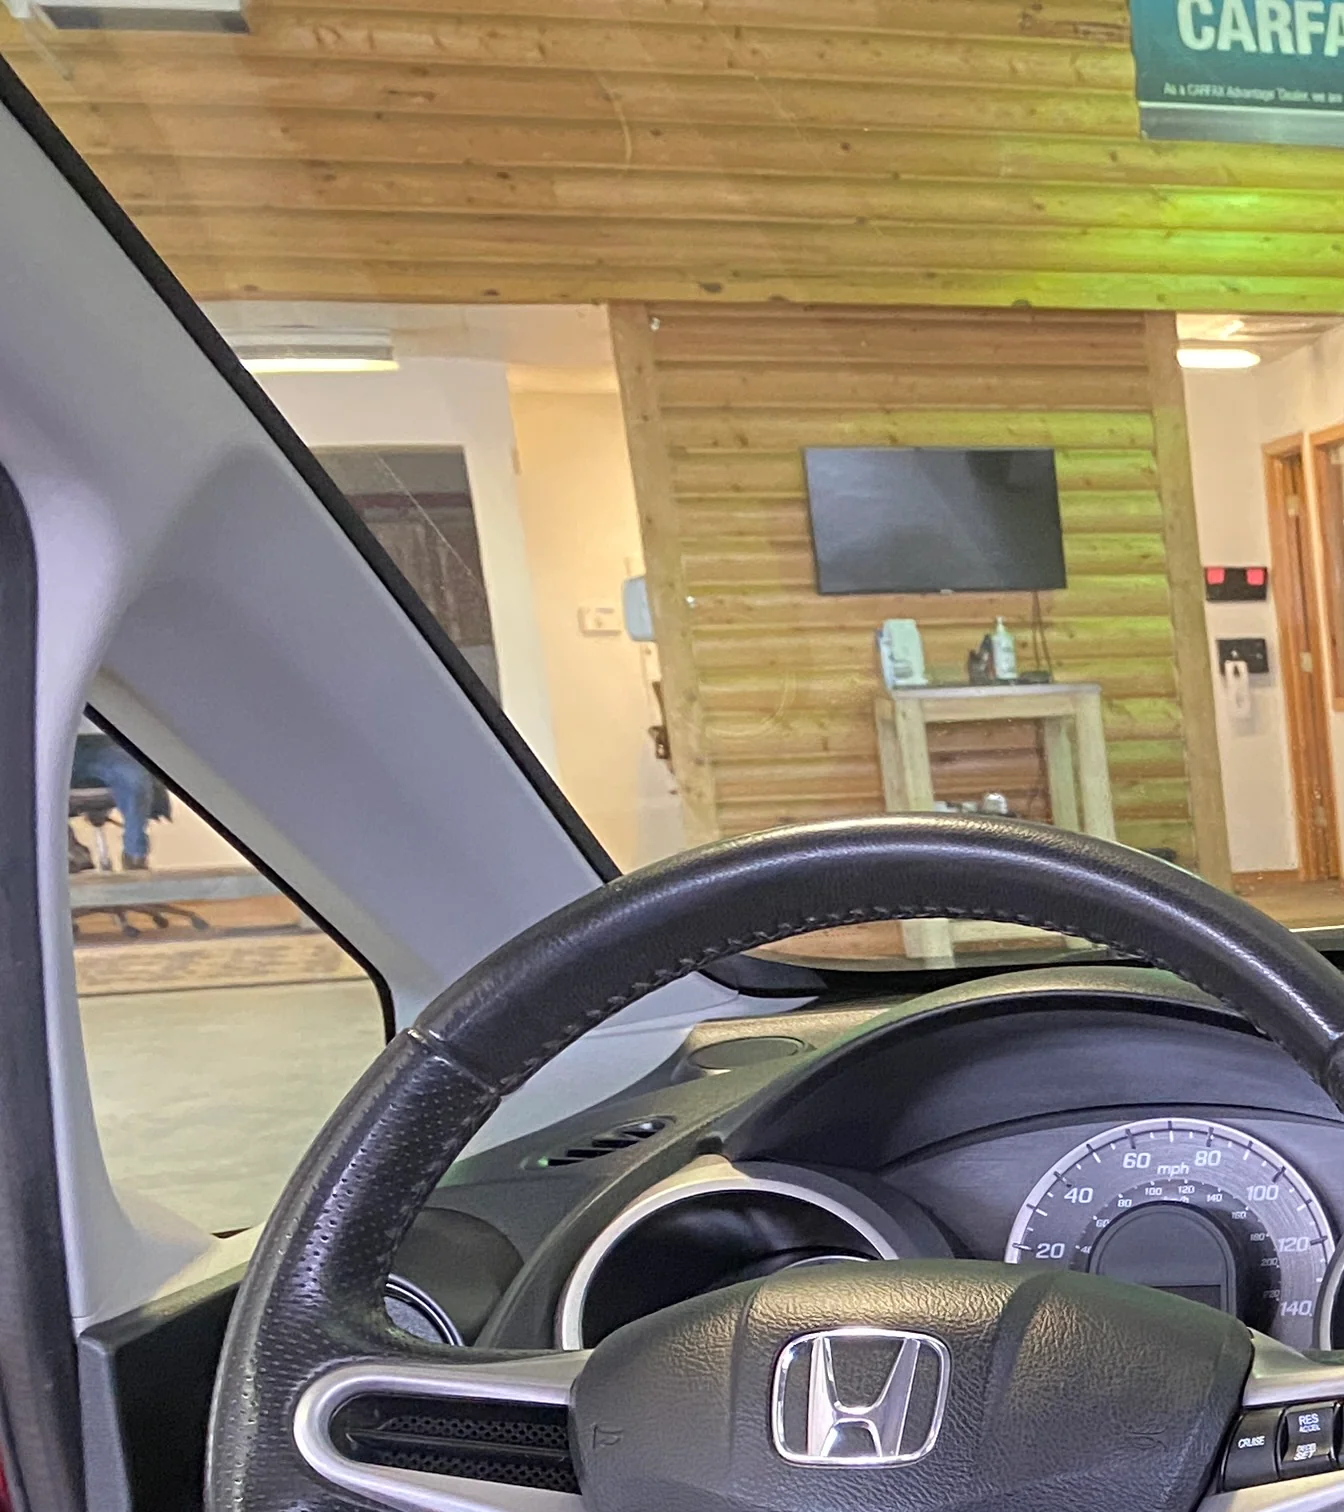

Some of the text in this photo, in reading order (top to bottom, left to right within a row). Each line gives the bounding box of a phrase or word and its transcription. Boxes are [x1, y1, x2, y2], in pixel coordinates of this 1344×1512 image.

[1122, 1153, 1151, 1169] 60
[1195, 1151, 1222, 1167] 80
[1157, 1163, 1189, 1177] mph
[1063, 1187, 1094, 1203] 40
[1144, 1187, 1163, 1196] 100
[1178, 1185, 1196, 1195] 120
[1206, 1193, 1223, 1202] 140
[1246, 1184, 1280, 1201] 100
[1117, 1199, 1133, 1208] 80
[1035, 1243, 1066, 1259] 20
[1278, 1236, 1310, 1252] 120
[1280, 1299, 1312, 1317] 140
[1298, 1413, 1319, 1425] RES
[1238, 1435, 1266, 1449] CRUISE
